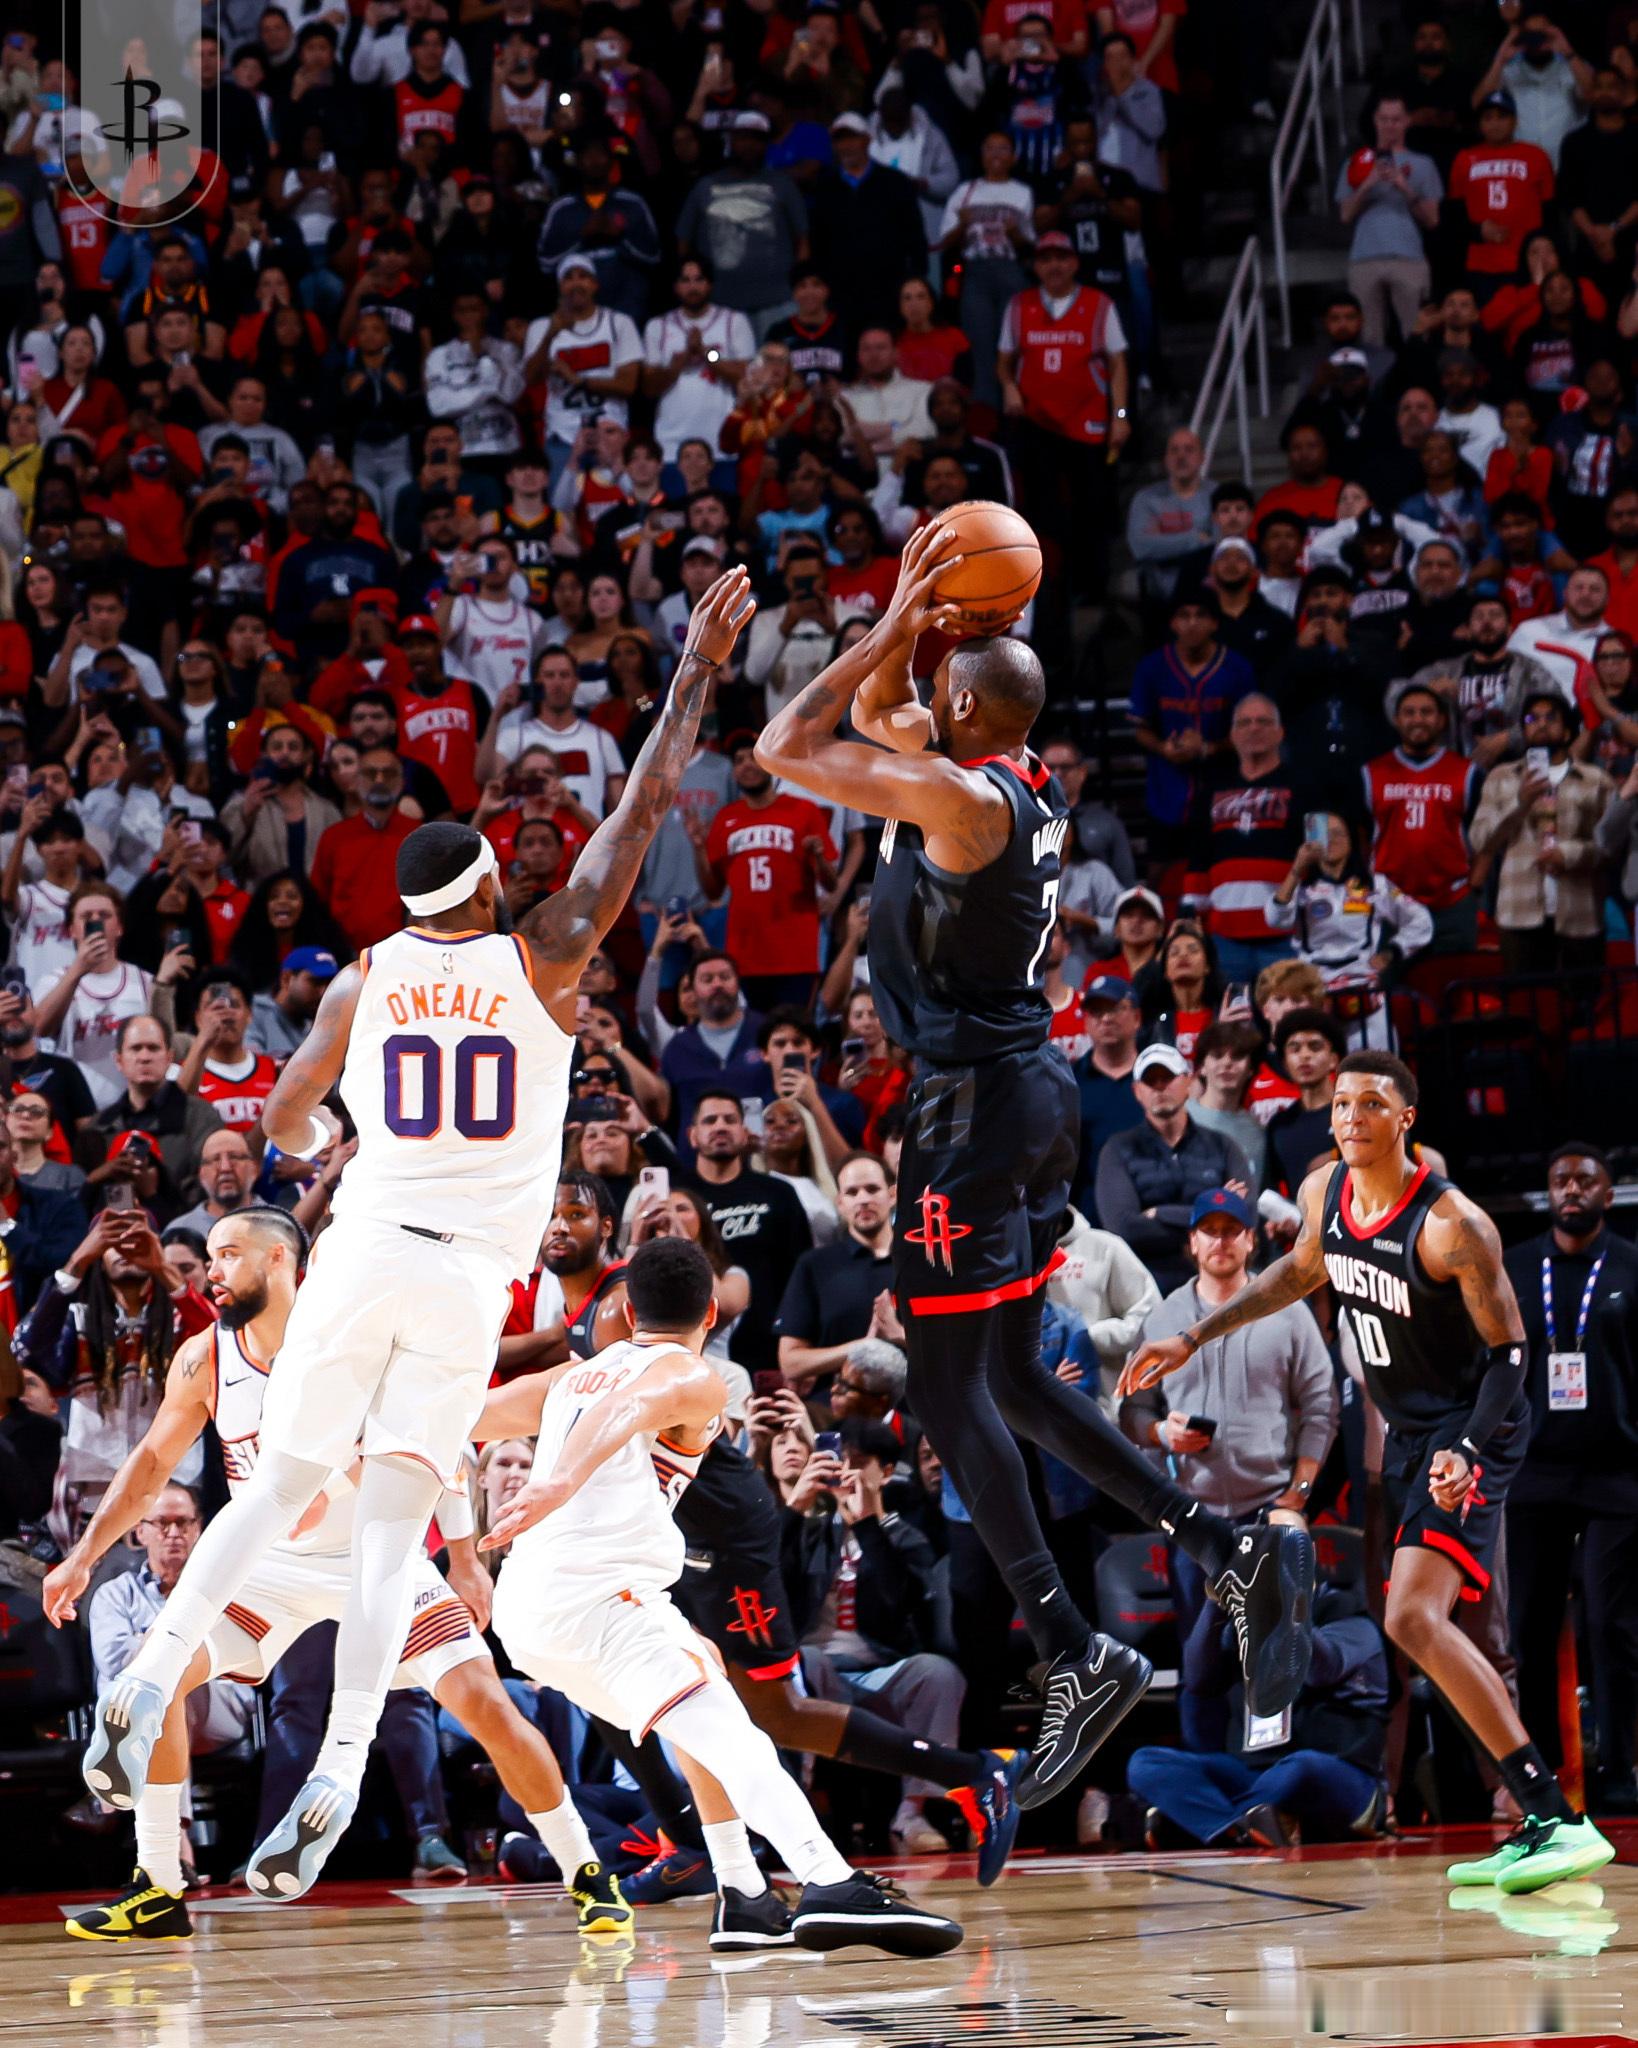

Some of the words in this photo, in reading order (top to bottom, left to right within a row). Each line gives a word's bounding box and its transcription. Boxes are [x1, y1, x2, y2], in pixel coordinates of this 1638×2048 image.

[1382, 782, 1453, 803] ROCKETS
[1404, 802, 1427, 831] 31
[746, 855, 774, 893] 15
[386, 983, 509, 1031] O'NEALE
[384, 1035, 517, 1141] 00
[1324, 1253, 1413, 1320] HOUSTON
[1350, 1307, 1393, 1369] 10
